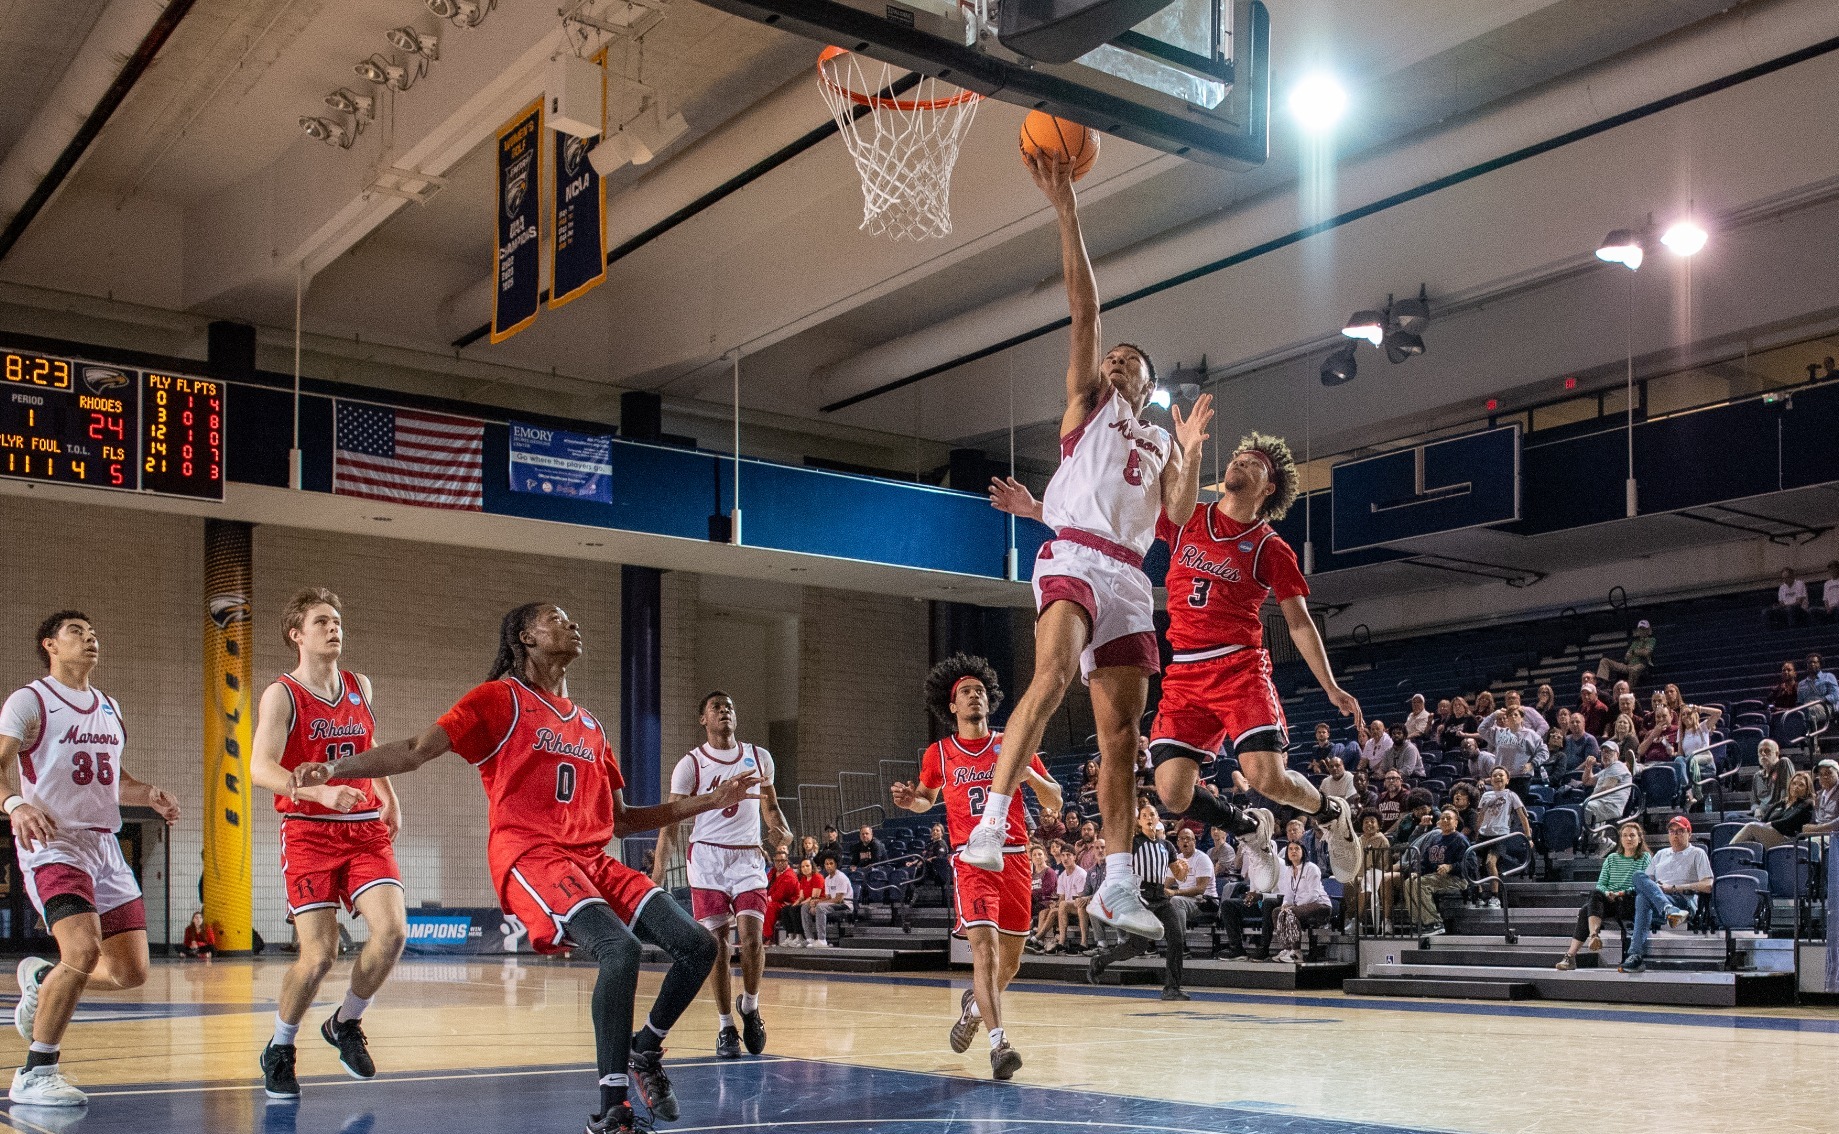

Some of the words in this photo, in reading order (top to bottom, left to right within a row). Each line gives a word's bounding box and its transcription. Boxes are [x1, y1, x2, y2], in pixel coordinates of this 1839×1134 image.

[565, 172, 590, 203] NCAA
[6, 354, 68, 387] 8:23
[150, 374, 171, 390] PLY
[176, 378, 192, 393] FL
[194, 380, 217, 396] PTS
[11, 393, 44, 406] PERIOD
[79, 395, 123, 413] RHODES
[156, 390, 167, 405] 0
[188, 396, 194, 408] 1
[209, 398, 220, 412] 4
[29, 408, 35, 427] 1
[89, 413, 124, 440] 24
[157, 408, 167, 422] 3
[182, 411, 193, 426] 0
[209, 414, 219, 429] 8
[0, 433, 24, 448] LYR
[31, 436, 62, 453] FOUL
[150, 423, 167, 439] 12
[188, 429, 194, 441] 1
[209, 431, 219, 446] 0
[513, 425, 554, 442] EMORY
[103, 446, 125, 461] FLS
[150, 441, 167, 456] 14
[182, 445, 193, 459] 0
[209, 448, 220, 462] 7
[516, 452, 528, 461] Go
[529, 455, 552, 464] where
[553, 458, 565, 466] the
[566, 460, 592, 471] players
[71, 460, 85, 479] 4
[110, 463, 123, 485] 5
[145, 457, 167, 472] 21
[182, 461, 193, 477] 0
[209, 465, 219, 480] 3
[1178, 544, 1241, 583] Rhodes
[1187, 576, 1213, 609] 3
[58, 724, 120, 746] Maroons
[308, 716, 366, 740] Rhodes
[532, 727, 596, 762] Rhodes
[71, 750, 114, 786] 35
[953, 762, 996, 787] Rhod
[555, 761, 577, 804] 0
[968, 785, 992, 817] 2
